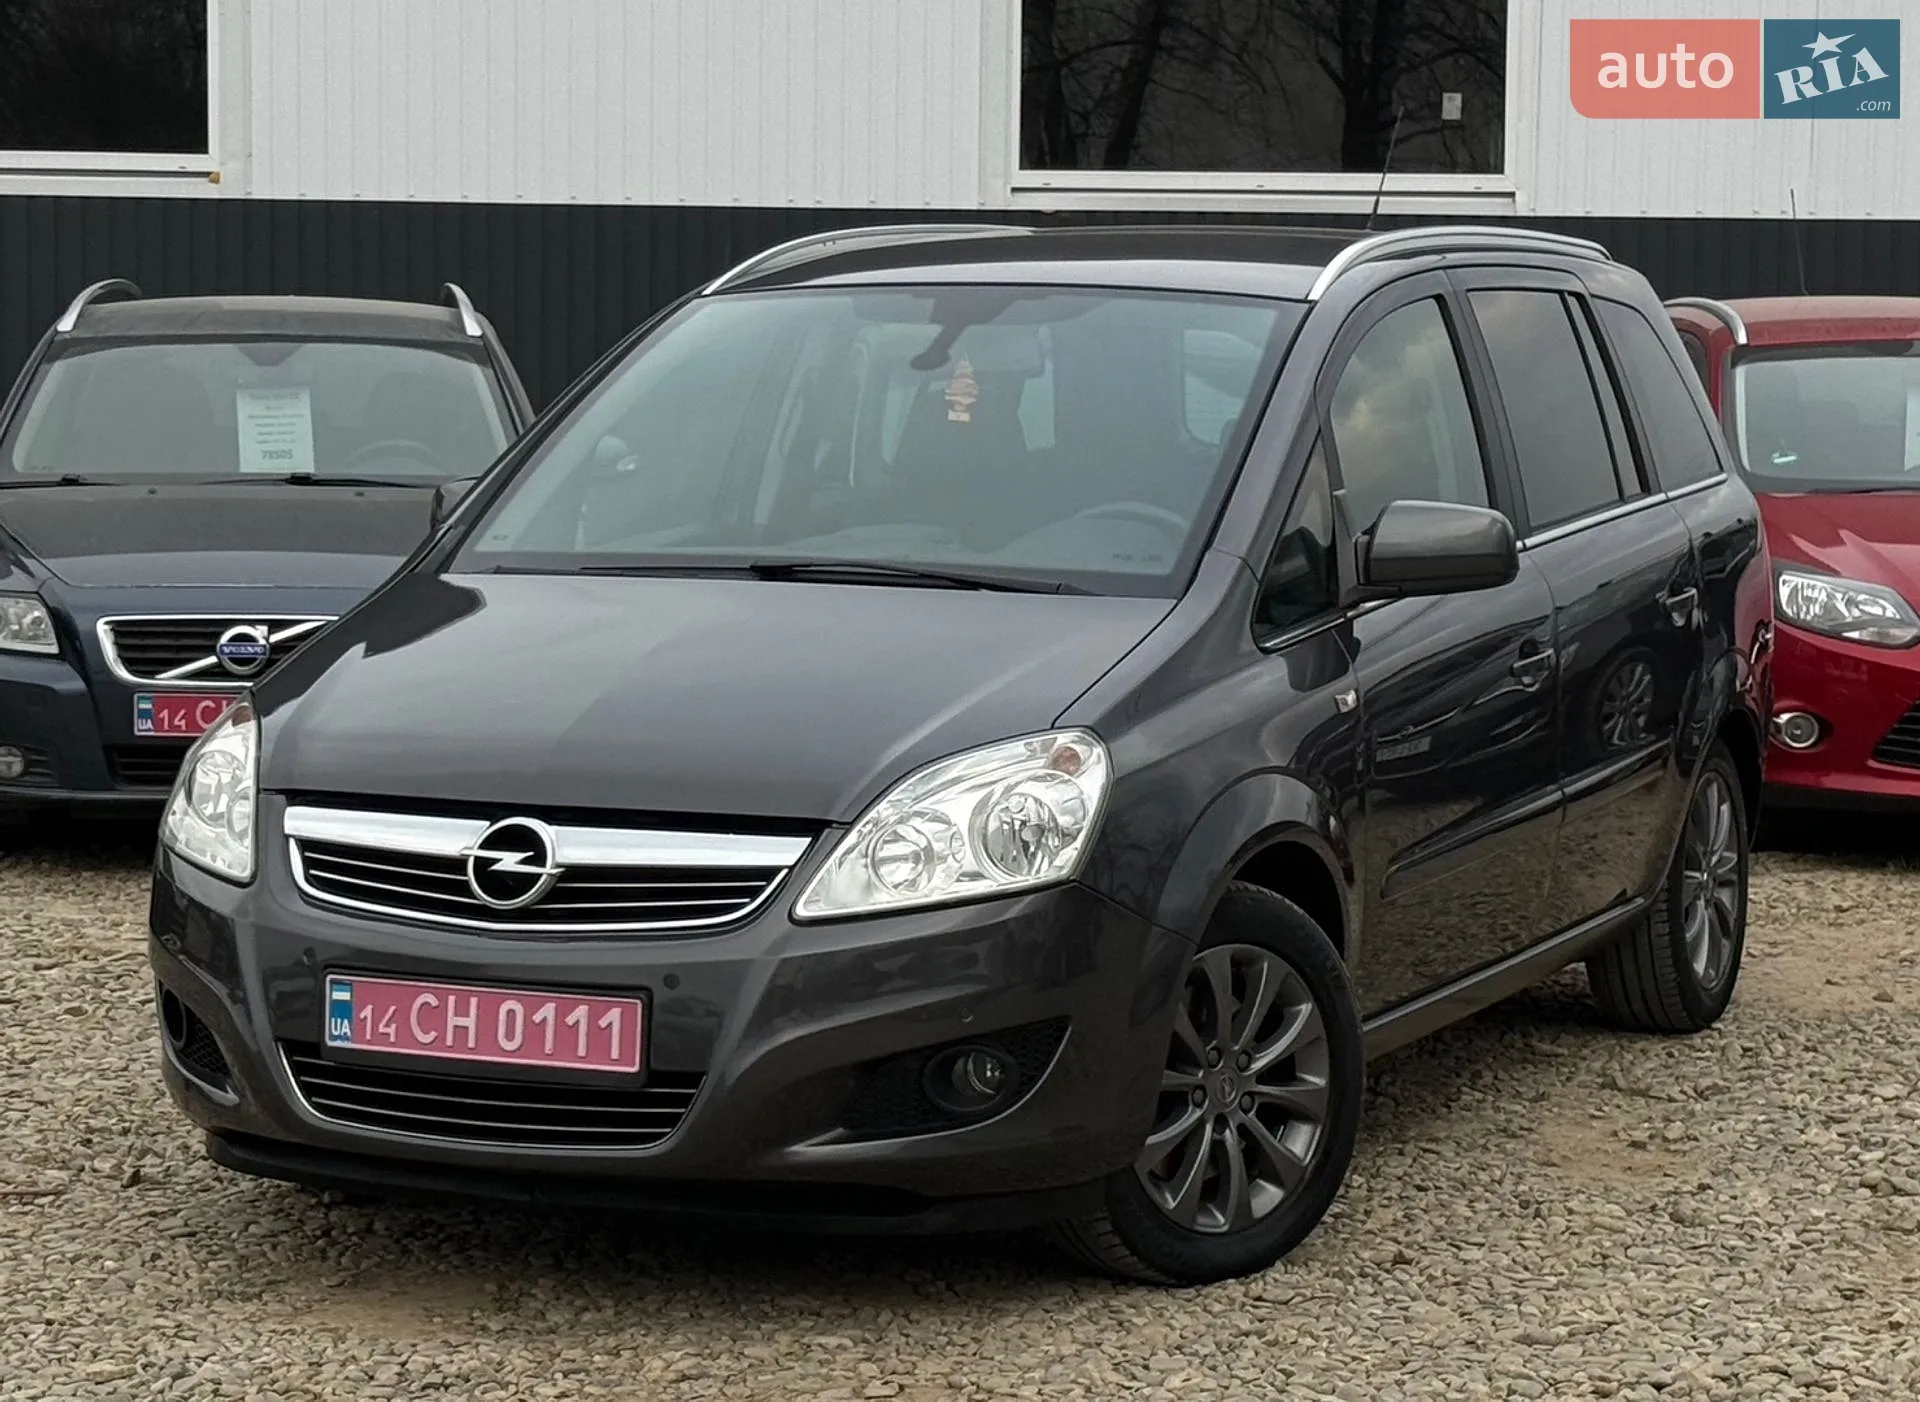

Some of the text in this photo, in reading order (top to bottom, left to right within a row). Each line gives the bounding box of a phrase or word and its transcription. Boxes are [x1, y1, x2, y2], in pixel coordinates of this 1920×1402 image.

[221, 645, 265, 654] VOLVO
[137, 718, 154, 730] UA
[158, 708, 187, 731] 14
[330, 1017, 352, 1037] UA
[359, 992, 623, 1061] 14 CH 0111
